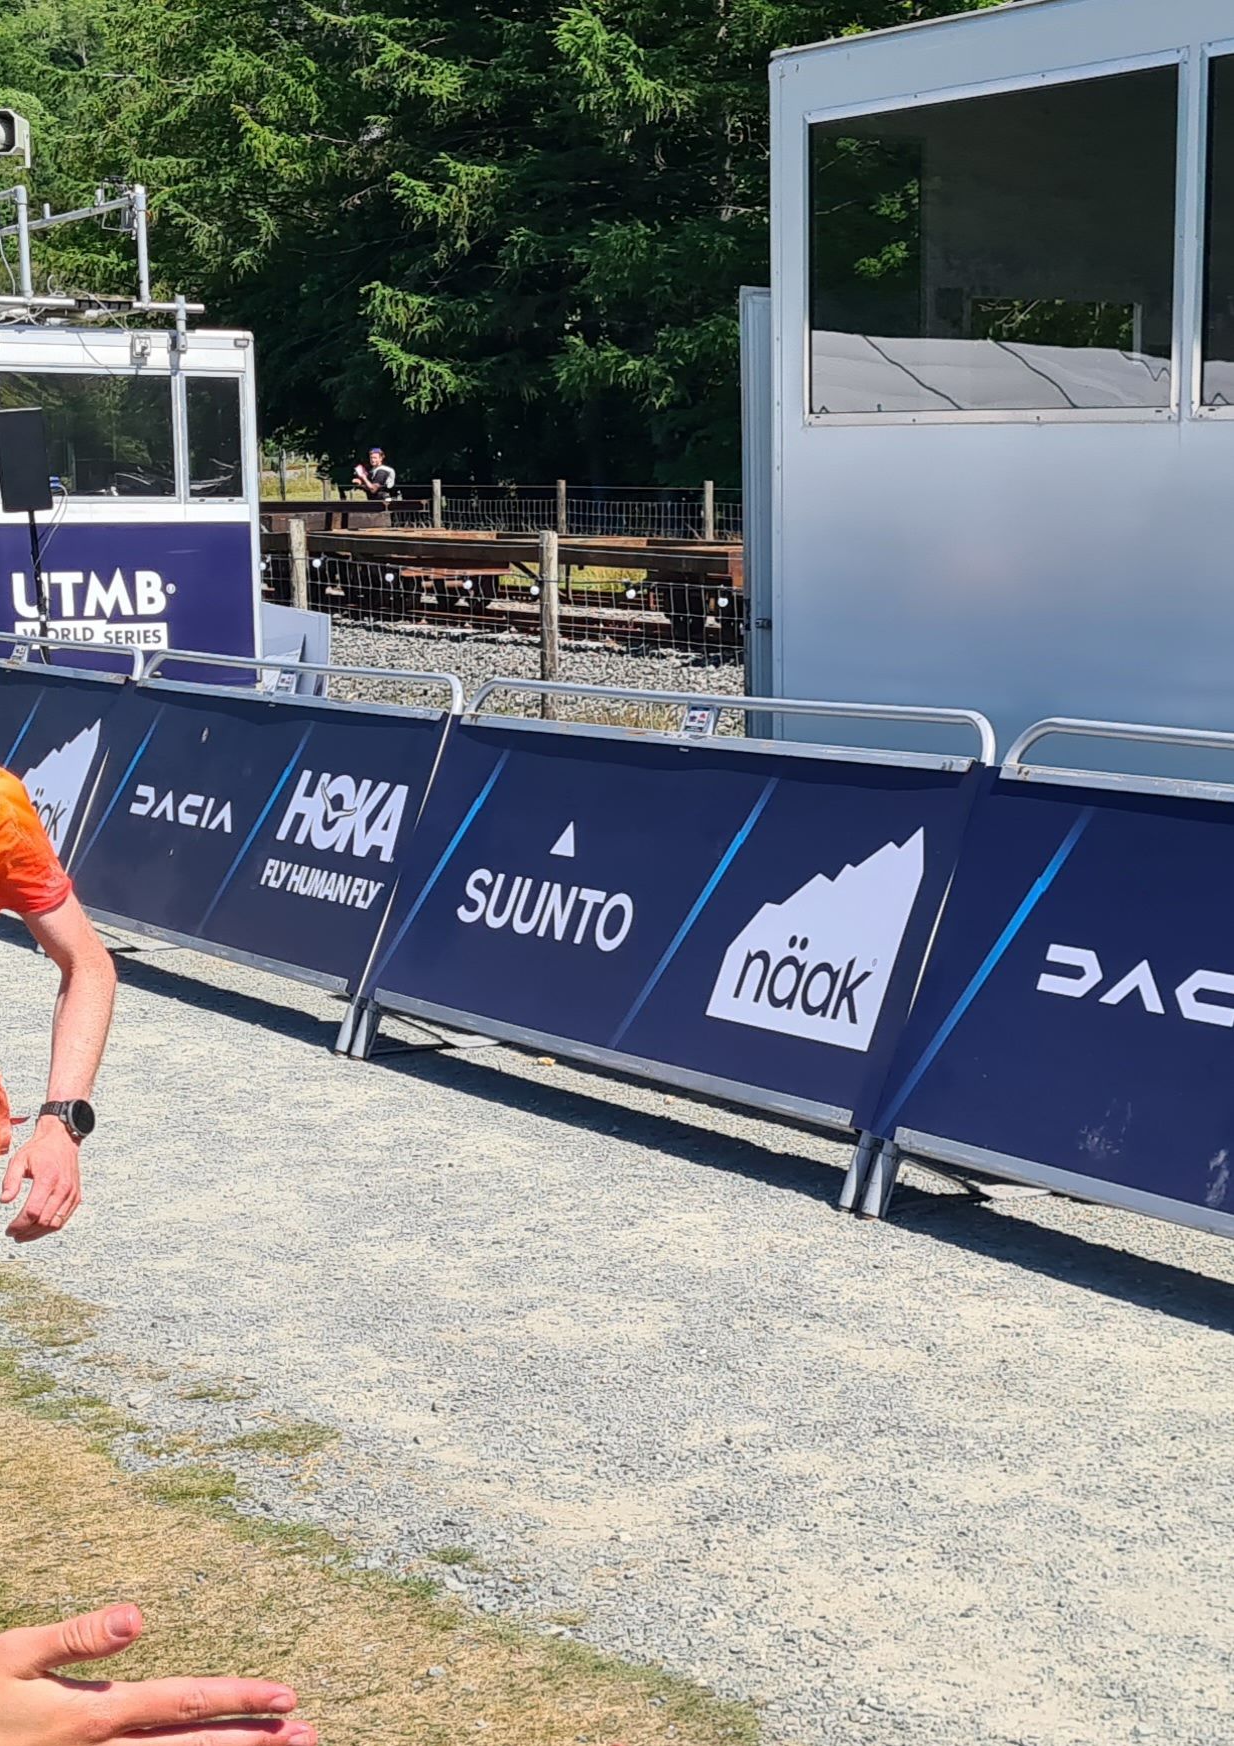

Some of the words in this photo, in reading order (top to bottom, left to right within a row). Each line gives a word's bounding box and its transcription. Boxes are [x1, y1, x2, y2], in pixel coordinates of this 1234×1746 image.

[12, 567, 167, 620] UTMB
[103, 629, 162, 646] SERIES
[129, 784, 233, 834] DACIA
[275, 769, 409, 863] HOKA
[260, 858, 293, 889] FLY
[286, 864, 353, 906] HUMAN
[346, 876, 382, 910] FLY
[457, 868, 634, 952] SUUNTO
[732, 935, 873, 1025] näak
